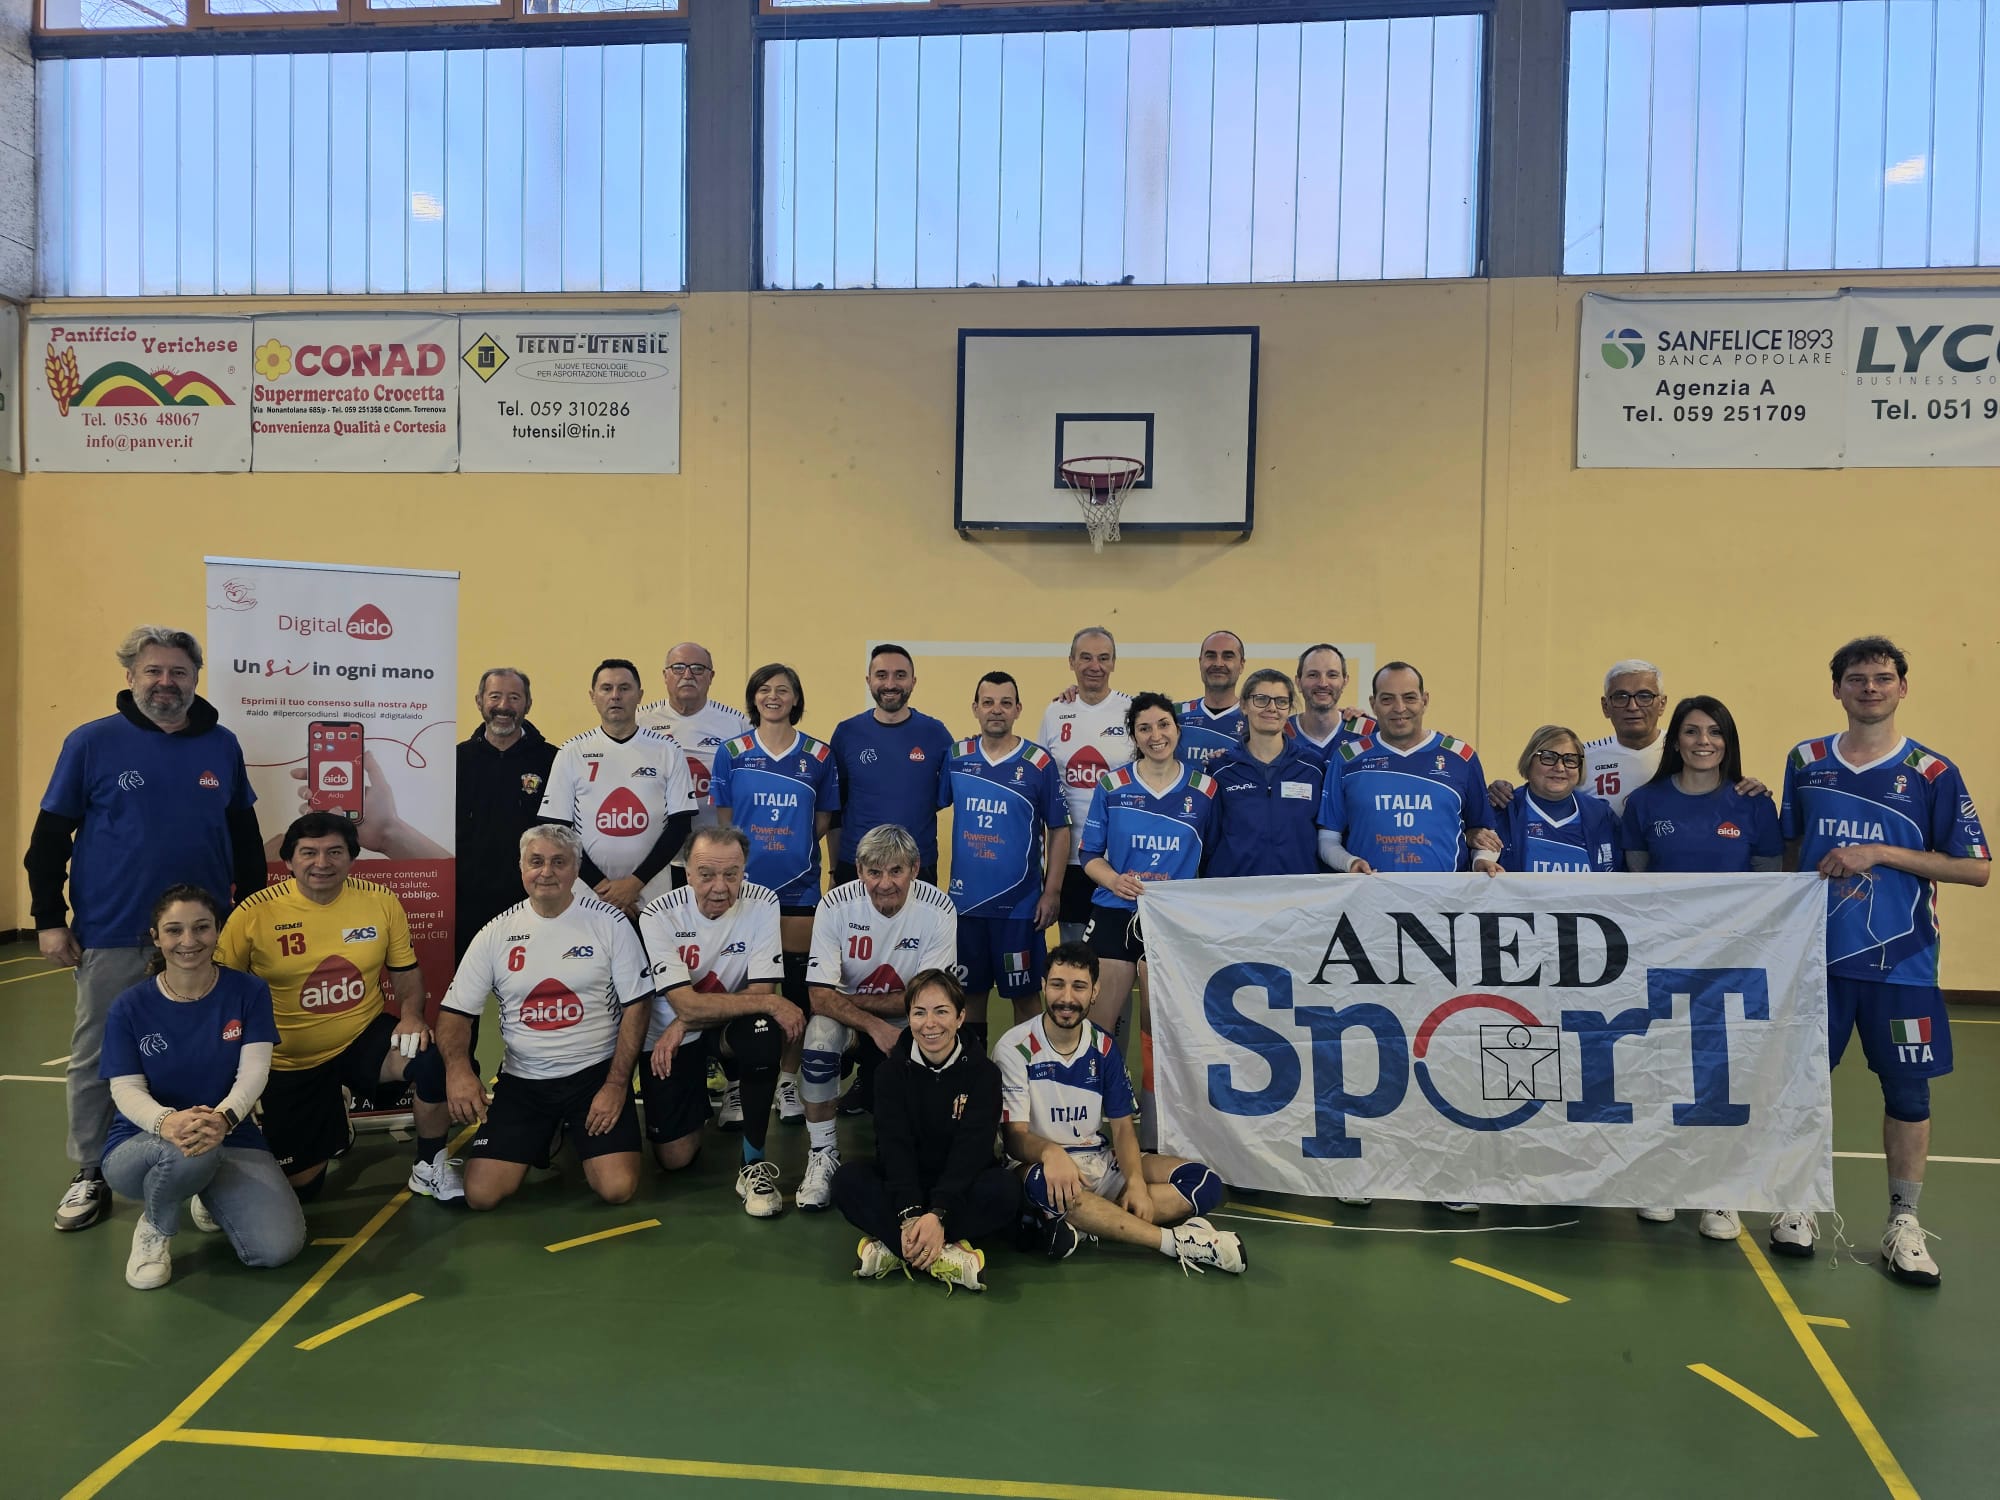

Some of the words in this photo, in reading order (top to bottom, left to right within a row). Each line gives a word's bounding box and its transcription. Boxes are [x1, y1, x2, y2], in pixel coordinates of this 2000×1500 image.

[51, 327, 137, 343] Panificio
[141, 336, 238, 354] Verichese
[1856, 324, 2000, 374] LYC
[295, 343, 446, 377] CONAD
[554, 362, 580, 370] NUOVE
[582, 362, 628, 370] TECNOLOGIE
[1657, 353, 1723, 366] BANCA
[1734, 352, 1832, 365] POPOLARE
[553, 370, 608, 378] ASPORTAZIONE
[610, 370, 646, 378] TRUCIOLO
[1856, 375, 1958, 385] BUSINESS
[254, 384, 370, 406] Supermercato
[373, 383, 445, 402] Crocetta
[1656, 379, 1751, 400] Agenzia
[1760, 379, 1776, 396] A
[253, 406, 263, 414] Via
[332, 406, 344, 414] Tel.
[344, 406, 357, 414] 059
[414, 406, 446, 414] Torrenova
[497, 400, 524, 416] Tel.
[530, 401, 562, 417] 059
[568, 401, 630, 417] 310286
[1622, 405, 1663, 422] Tel.
[1672, 404, 1714, 422] 059
[1723, 404, 1807, 422] 251709
[1871, 399, 1917, 420] Tel.
[1927, 398, 1971, 419] 051
[1983, 398, 2000, 419] 9
[81, 412, 106, 426] Tel.
[114, 412, 148, 426] 0536
[156, 412, 200, 427] 48067
[252, 421, 330, 434] Convenienza
[333, 420, 381, 436] Qualità
[383, 424, 391, 434] e
[393, 420, 446, 434] Cortesia
[512, 422, 616, 439] tutensil@tin.it
[86, 434, 194, 452] info@panver.it
[278, 615, 343, 636] Digital
[346, 618, 392, 636] aido
[233, 658, 261, 674] Un
[313, 661, 330, 676] in
[336, 663, 376, 680] ogni
[381, 665, 435, 680] mano
[241, 697, 279, 707] Esprimi
[279, 698, 287, 706] il
[288, 698, 305, 707] tuo
[307, 699, 351, 708] consenso
[353, 700, 376, 708] sulla
[378, 701, 408, 709] nostra
[409, 702, 428, 711] App
[379, 712, 423, 721] #digitalaido
[1060, 723, 1073, 742] 8
[909, 752, 925, 760] aido
[587, 761, 599, 783] 7
[1595, 762, 1618, 771] GEMS
[199, 777, 220, 787] aido
[323, 774, 348, 784] aido
[1594, 771, 1621, 796] 15
[753, 792, 798, 808] ITALIA
[966, 797, 1008, 815] ITALIA
[1375, 794, 1433, 811] ITALIA
[597, 806, 648, 829] aido
[770, 809, 780, 822] 3
[976, 814, 993, 829] 12
[1393, 812, 1415, 828] 10
[750, 823, 790, 836] Powered
[963, 831, 999, 843] Powered
[1717, 826, 1741, 838] aido
[1818, 818, 1885, 841] ITALIA
[1131, 834, 1180, 852] ITALIA
[1375, 833, 1425, 845] Powered
[1150, 853, 1160, 866] 2
[394, 870, 438, 879] contenuti
[389, 881, 398, 889] la
[400, 881, 430, 889] salute.
[402, 890, 440, 900] obbligo.
[274, 922, 303, 931] GEMS
[427, 931, 448, 940] (CIE)
[276, 932, 307, 957] 13
[847, 935, 873, 961] 10
[1308, 911, 1630, 988] ANED
[508, 946, 526, 972] 6
[677, 944, 700, 970] 16
[1008, 971, 1031, 987] ITA
[301, 976, 365, 1008] aido
[520, 998, 583, 1023] aido
[1897, 1044, 1935, 1064] ITA
